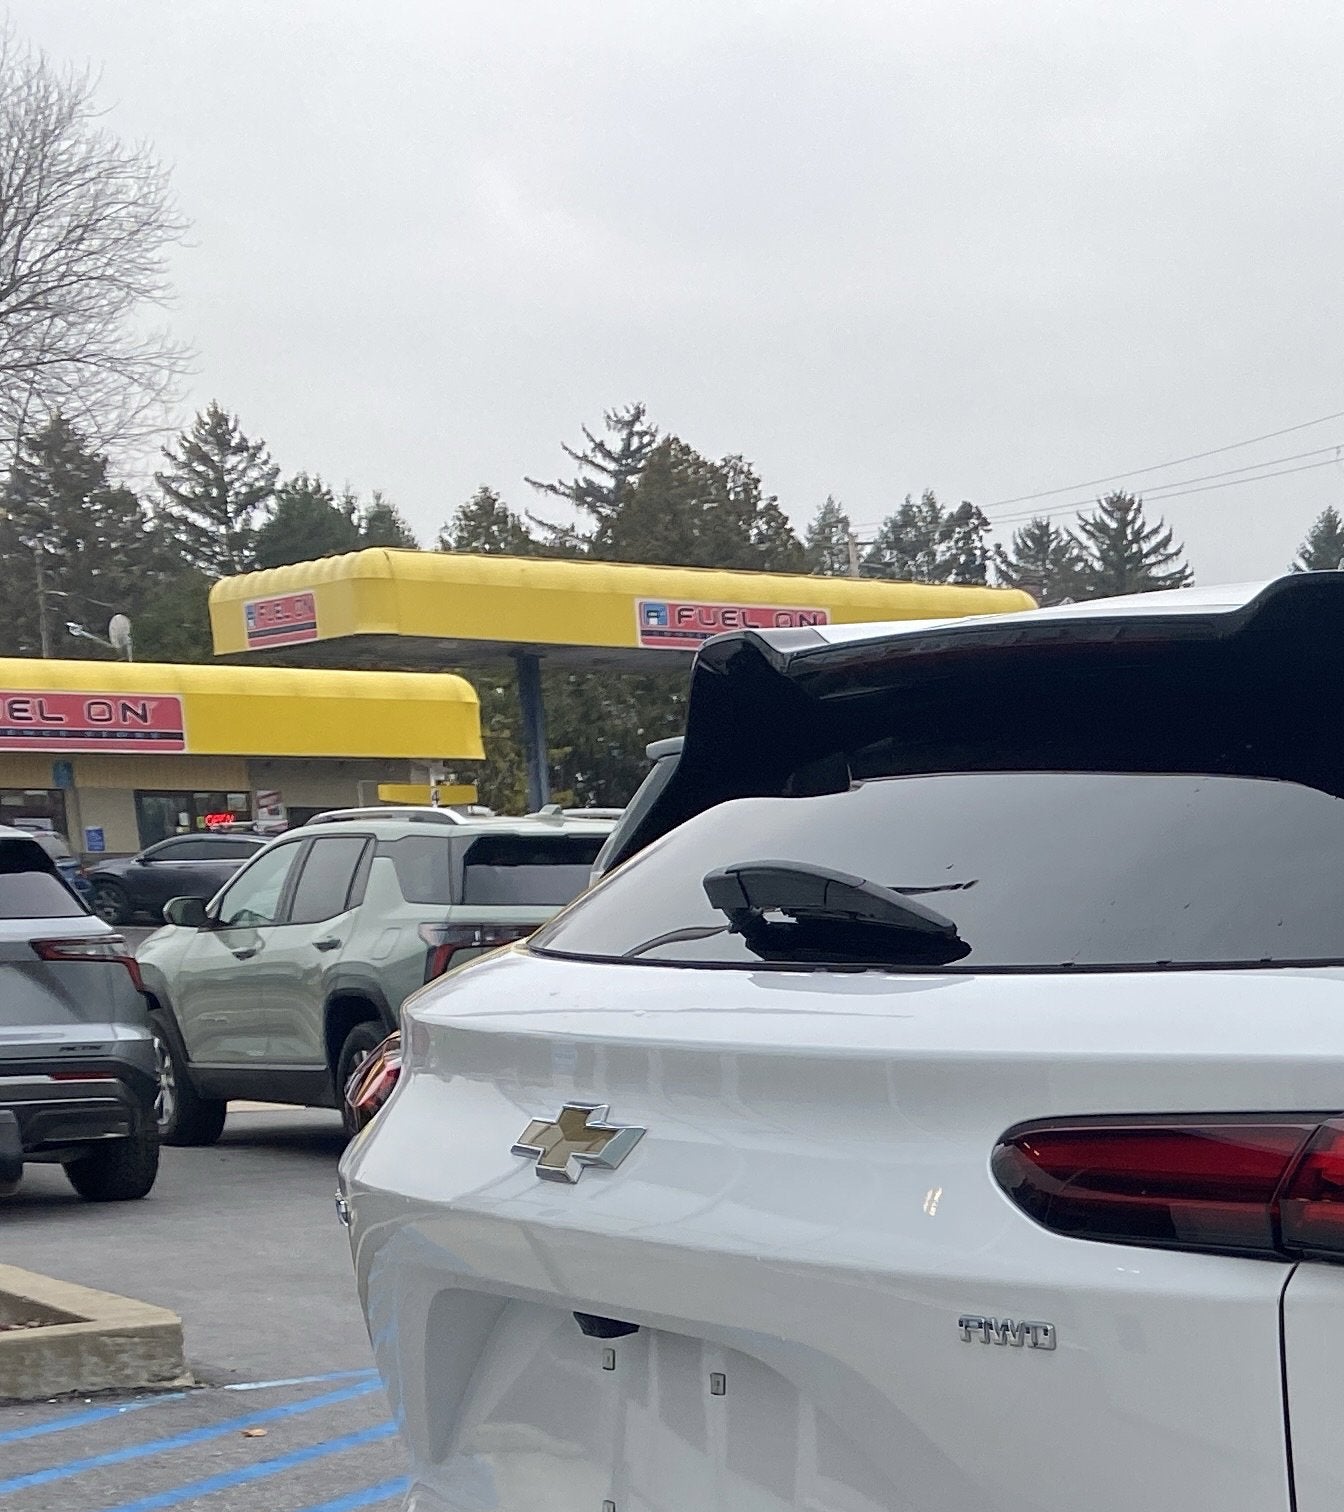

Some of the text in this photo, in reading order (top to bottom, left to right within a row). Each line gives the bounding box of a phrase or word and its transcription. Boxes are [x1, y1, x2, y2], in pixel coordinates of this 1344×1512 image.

[259, 594, 314, 623] FUEL ON
[676, 606, 819, 629] FUEL ON
[0, 697, 150, 725] EL ON
[958, 1314, 1057, 1351] RWD
